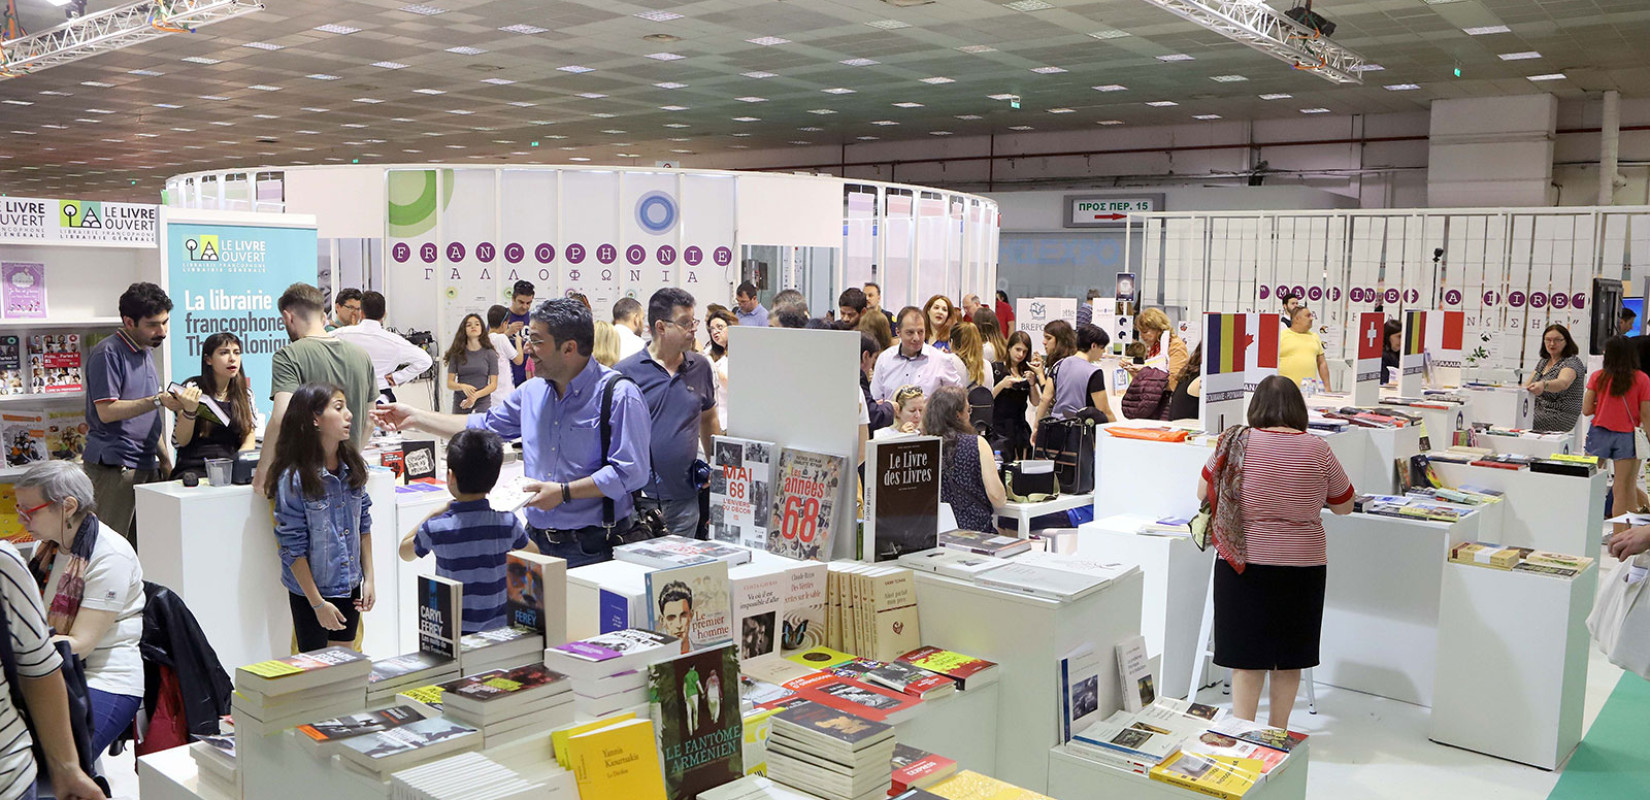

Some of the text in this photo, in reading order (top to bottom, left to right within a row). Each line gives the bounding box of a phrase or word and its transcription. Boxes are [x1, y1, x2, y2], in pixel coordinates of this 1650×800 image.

[6, 201, 45, 214] LIVRE
[105, 206, 155, 220] LE LIVRE
[1079, 202, 1148, 211] ΠΡΟΣ ΠΕΡ. 15
[105, 219, 155, 231] OUVERT
[221, 240, 266, 251] LE LIVRE
[396, 246, 728, 263] FRANCOPHONIE
[221, 251, 266, 262] OUVERT
[425, 267, 698, 283] ΓΑΛΛΟΦΩΝΙΑ
[184, 289, 272, 311] La librairie
[185, 311, 286, 337] francophone
[889, 450, 928, 470] Le Livre
[723, 464, 753, 483] MAI
[884, 467, 932, 486] des Livres
[729, 481, 745, 499] 68
[784, 475, 825, 499] années
[782, 495, 820, 543] 68
[420, 605, 444, 624] CARYL
[695, 611, 706, 621] Le
[692, 615, 725, 633] premier
[697, 626, 729, 639] homme
[665, 724, 741, 760] LE FANTÔME
